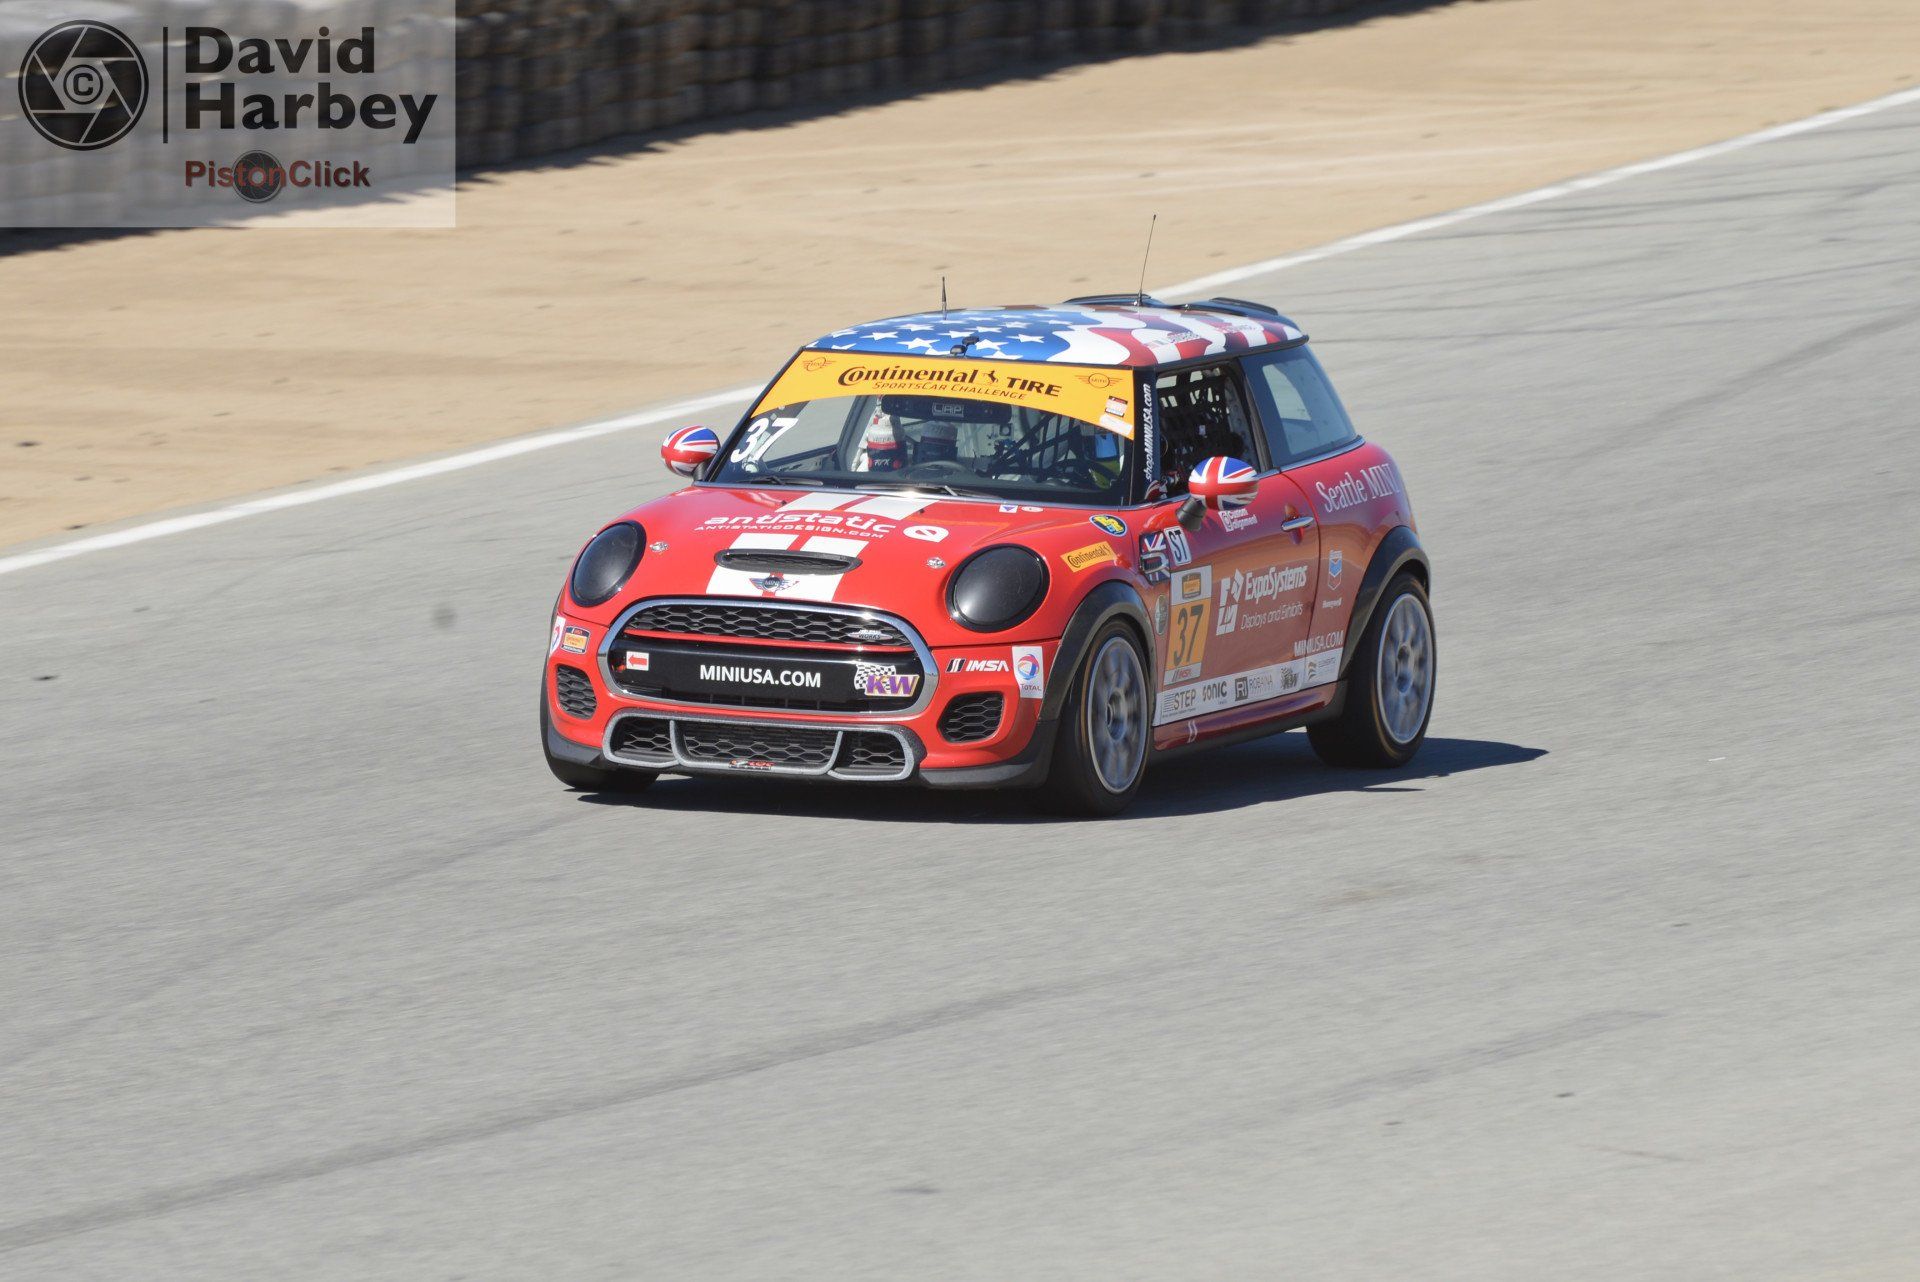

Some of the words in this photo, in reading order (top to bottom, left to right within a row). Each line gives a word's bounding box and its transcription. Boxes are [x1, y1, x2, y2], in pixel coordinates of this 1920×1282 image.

[838, 365, 979, 387] Continental
[1006, 376, 1063, 397] TIRE
[950, 384, 1027, 400] CHALLENGE
[730, 417, 799, 463] 37
[1142, 383, 1154, 482] shopMINIUSA.com
[1315, 471, 1368, 513] Seattle
[694, 524, 884, 539] ANTISTATICDESIGN.COM
[704, 511, 897, 534] antistatic
[1067, 545, 1108, 568] Continental
[1168, 529, 1188, 563] ST
[1245, 565, 1308, 604] ExpoSystems
[1173, 603, 1204, 666] 37
[1294, 630, 1344, 657] MINIUSA.COM
[699, 664, 821, 689] MINIUSA.COM
[965, 659, 1010, 672] IMSA
[865, 674, 918, 696] KW
[1020, 683, 1042, 692] TOTAL
[1173, 688, 1197, 711] STEP
